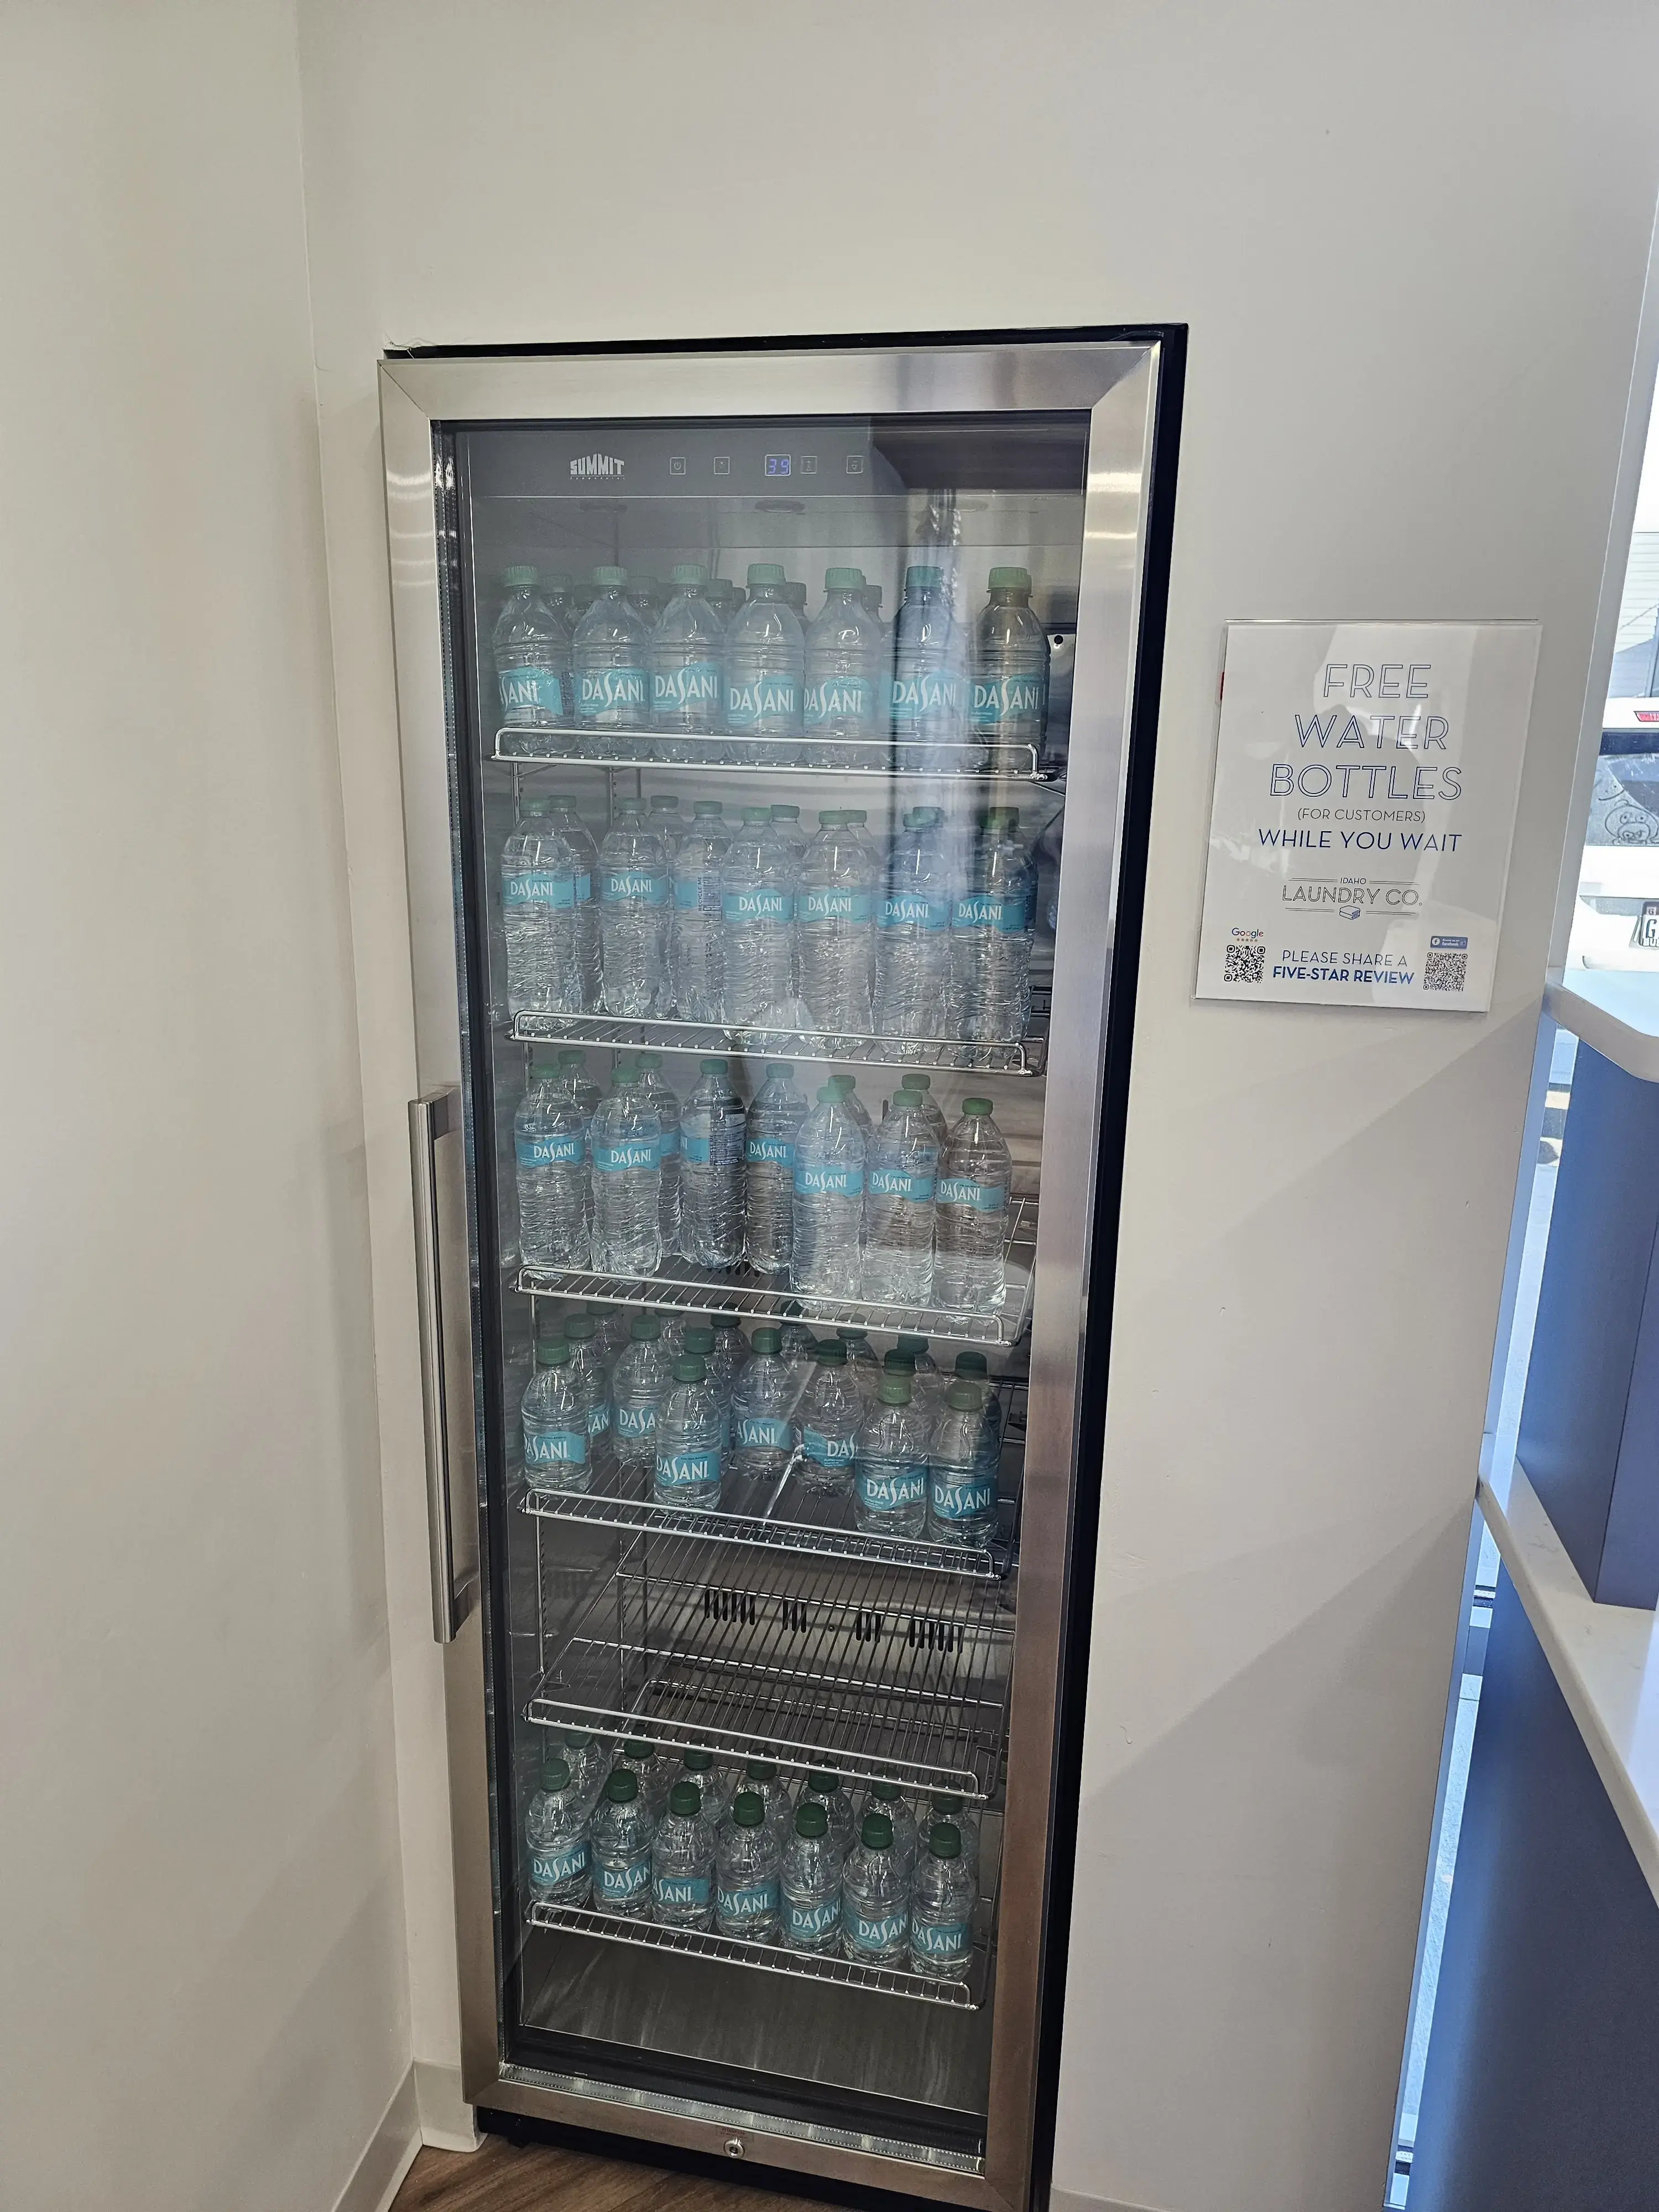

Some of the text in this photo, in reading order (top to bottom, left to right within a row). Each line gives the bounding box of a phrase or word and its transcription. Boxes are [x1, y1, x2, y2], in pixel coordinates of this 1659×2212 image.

[570, 453, 624, 474] SUMMIT
[768, 458, 789, 474] 39
[582, 672, 645, 707] DASANI
[655, 669, 718, 705] DASANI
[1323, 664, 1432, 698] FREE
[499, 676, 539, 712] SANI
[730, 681, 795, 718] DASANI
[804, 682, 863, 719] DASANI
[893, 675, 957, 713] DASANI
[974, 679, 1040, 717] DASANI
[1295, 714, 1449, 750] WATER
[1270, 764, 1462, 800] BOTTLES
[1297, 808, 1426, 823] (FOR CUSTOMERS)
[1259, 828, 1462, 852] WHILE YOU WAIT
[510, 878, 554, 900] DASANI
[611, 875, 652, 896] DASANI
[1282, 885, 1422, 906] LAUNDRY CO.
[739, 894, 782, 916] DASANI
[808, 894, 852, 916] DASANI
[885, 899, 929, 921] DASANI
[958, 900, 1003, 924] DASANI
[1232, 927, 1264, 939] Google
[1282, 950, 1407, 967] PLEASE SHARE A
[1272, 966, 1415, 984] FIVE-STAR REVIEW
[534, 1142, 575, 1162] DASANI
[611, 1147, 651, 1167] DASANI
[750, 1141, 787, 1159] DASANI
[805, 1171, 847, 1192] DASANI
[873, 1170, 912, 1192] DASANI
[941, 1181, 981, 1202] DASANI
[619, 1408, 655, 1434] DASA
[737, 1419, 777, 1444] ASANI
[827, 1431, 855, 1460] DAS
[656, 1455, 708, 1484] DASANI
[866, 1472, 924, 1504] DASANI
[935, 1483, 990, 1517] DASANI
[534, 1851, 585, 1882] DASANI
[604, 1862, 651, 1893] DASAN
[652, 1877, 691, 1902] ASANI
[717, 1887, 768, 1916] DASANI
[912, 1917, 963, 1951] DASANI
